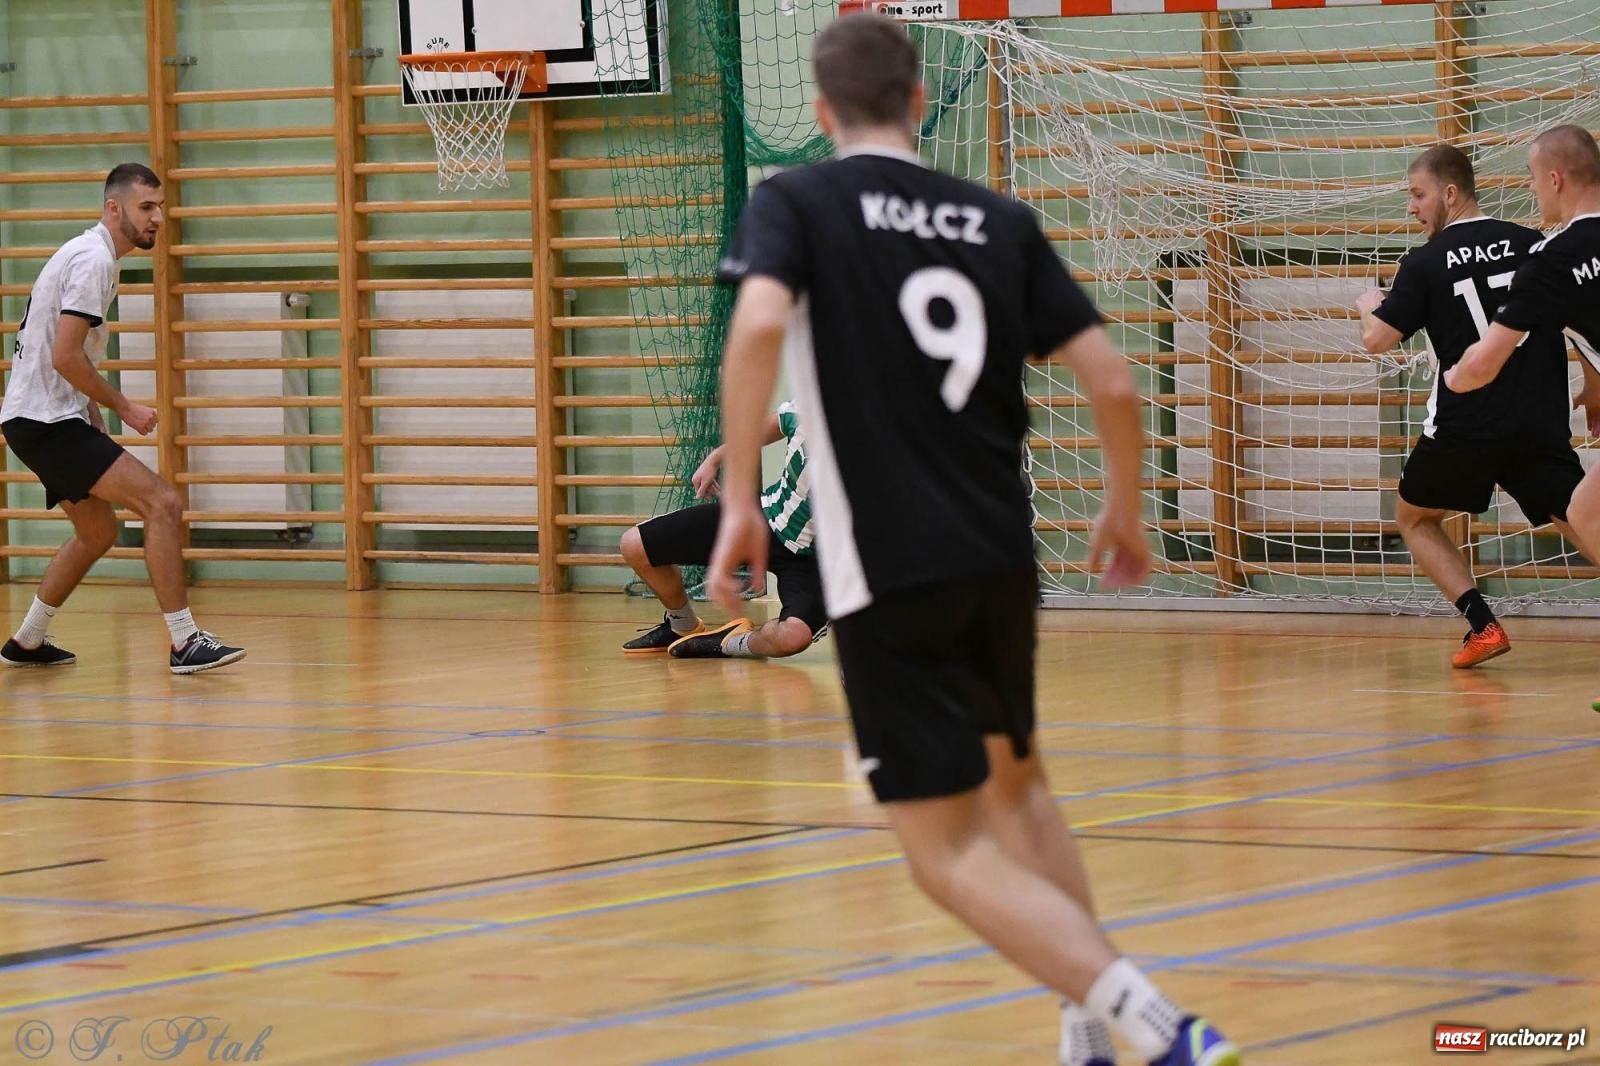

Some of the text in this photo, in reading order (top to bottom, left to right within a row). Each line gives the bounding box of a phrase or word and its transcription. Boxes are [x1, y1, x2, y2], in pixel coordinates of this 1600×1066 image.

[860, 191, 988, 246] KOŁCZ
[1446, 239, 1515, 270] APACZ
[898, 266, 988, 413] 9
